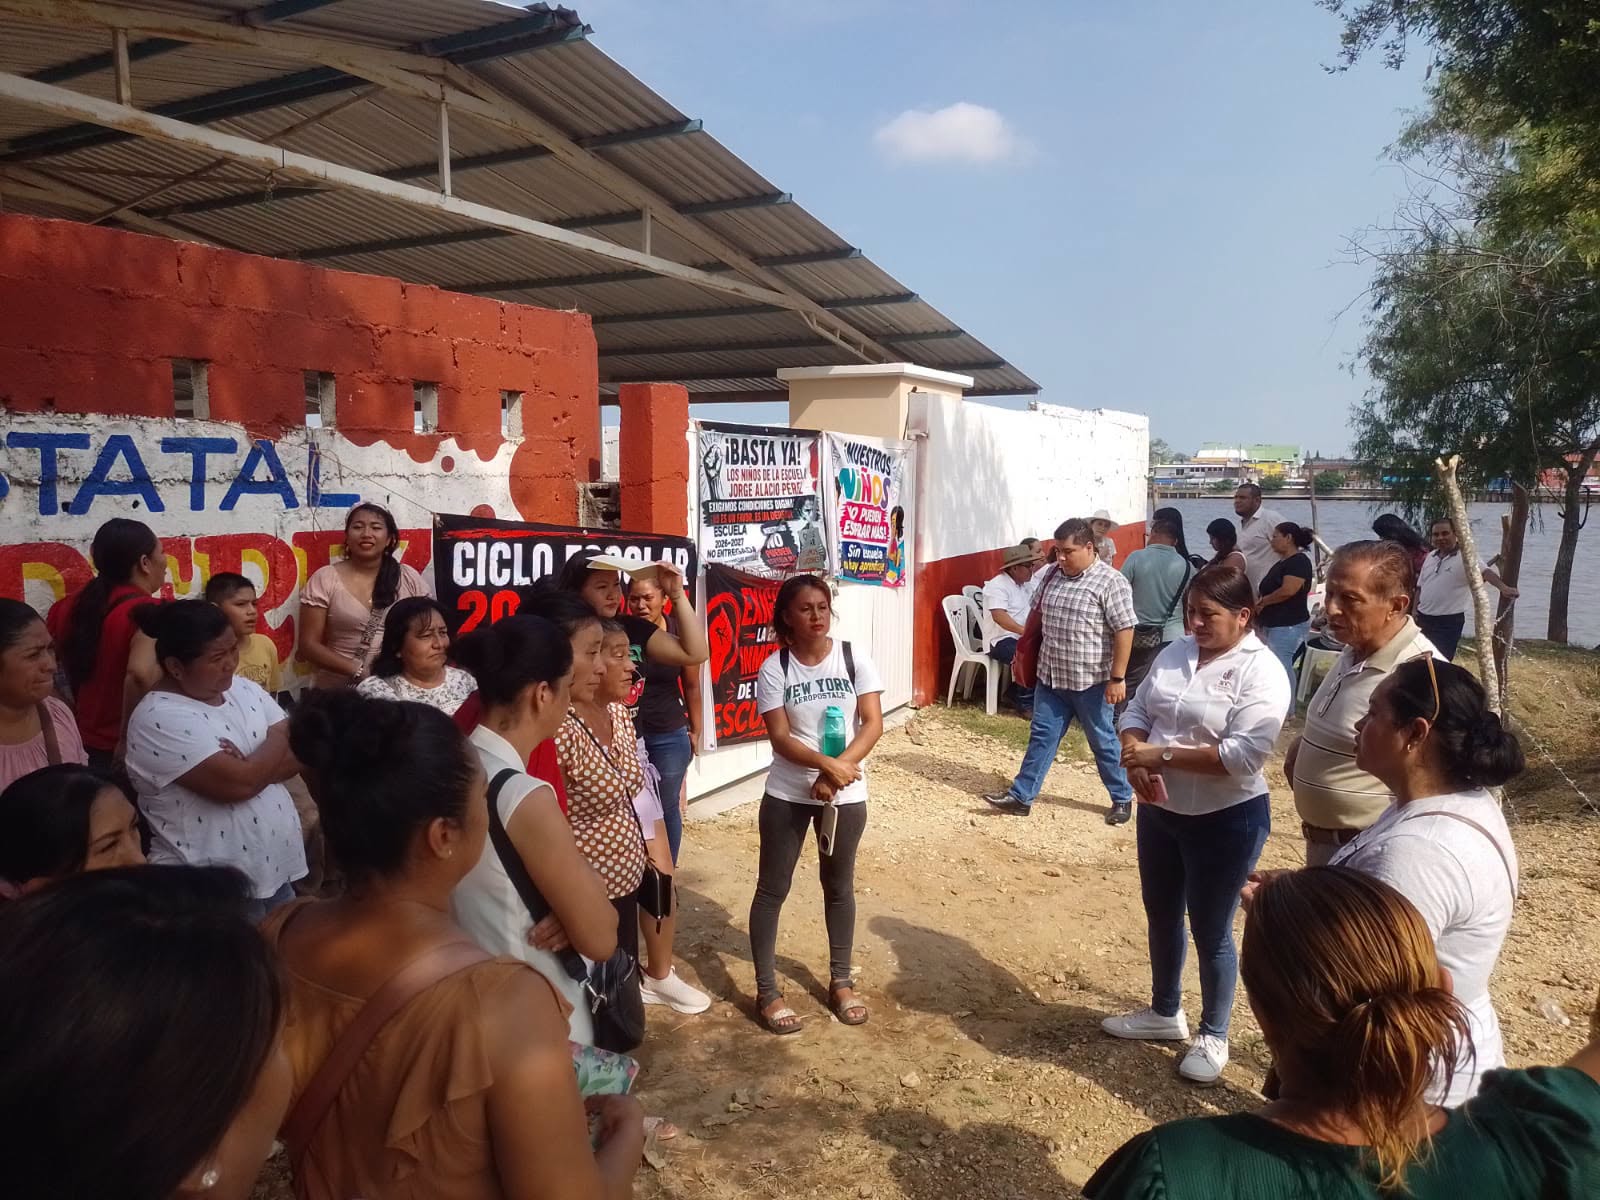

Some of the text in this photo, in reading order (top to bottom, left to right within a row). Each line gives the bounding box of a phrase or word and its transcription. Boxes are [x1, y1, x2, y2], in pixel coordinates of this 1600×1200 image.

[725, 438, 801, 466] ¡BASTA YA!
[0, 432, 361, 515] TATAL
[727, 468, 739, 481] LOS
[741, 466, 760, 481] NIÑOS
[763, 469, 771, 481] DE
[772, 470, 780, 481] LA
[729, 484, 753, 497] JORGE
[755, 483, 780, 496] ALACIO
[714, 525, 747, 537] ESCUELA
[766, 533, 783, 549] NO
[707, 549, 716, 558] NO
[848, 544, 861, 558] Sin
[452, 541, 553, 587] CICLO
[756, 627, 768, 642] LA
[737, 683, 752, 700] DE
[785, 677, 853, 703] NEW YORK
